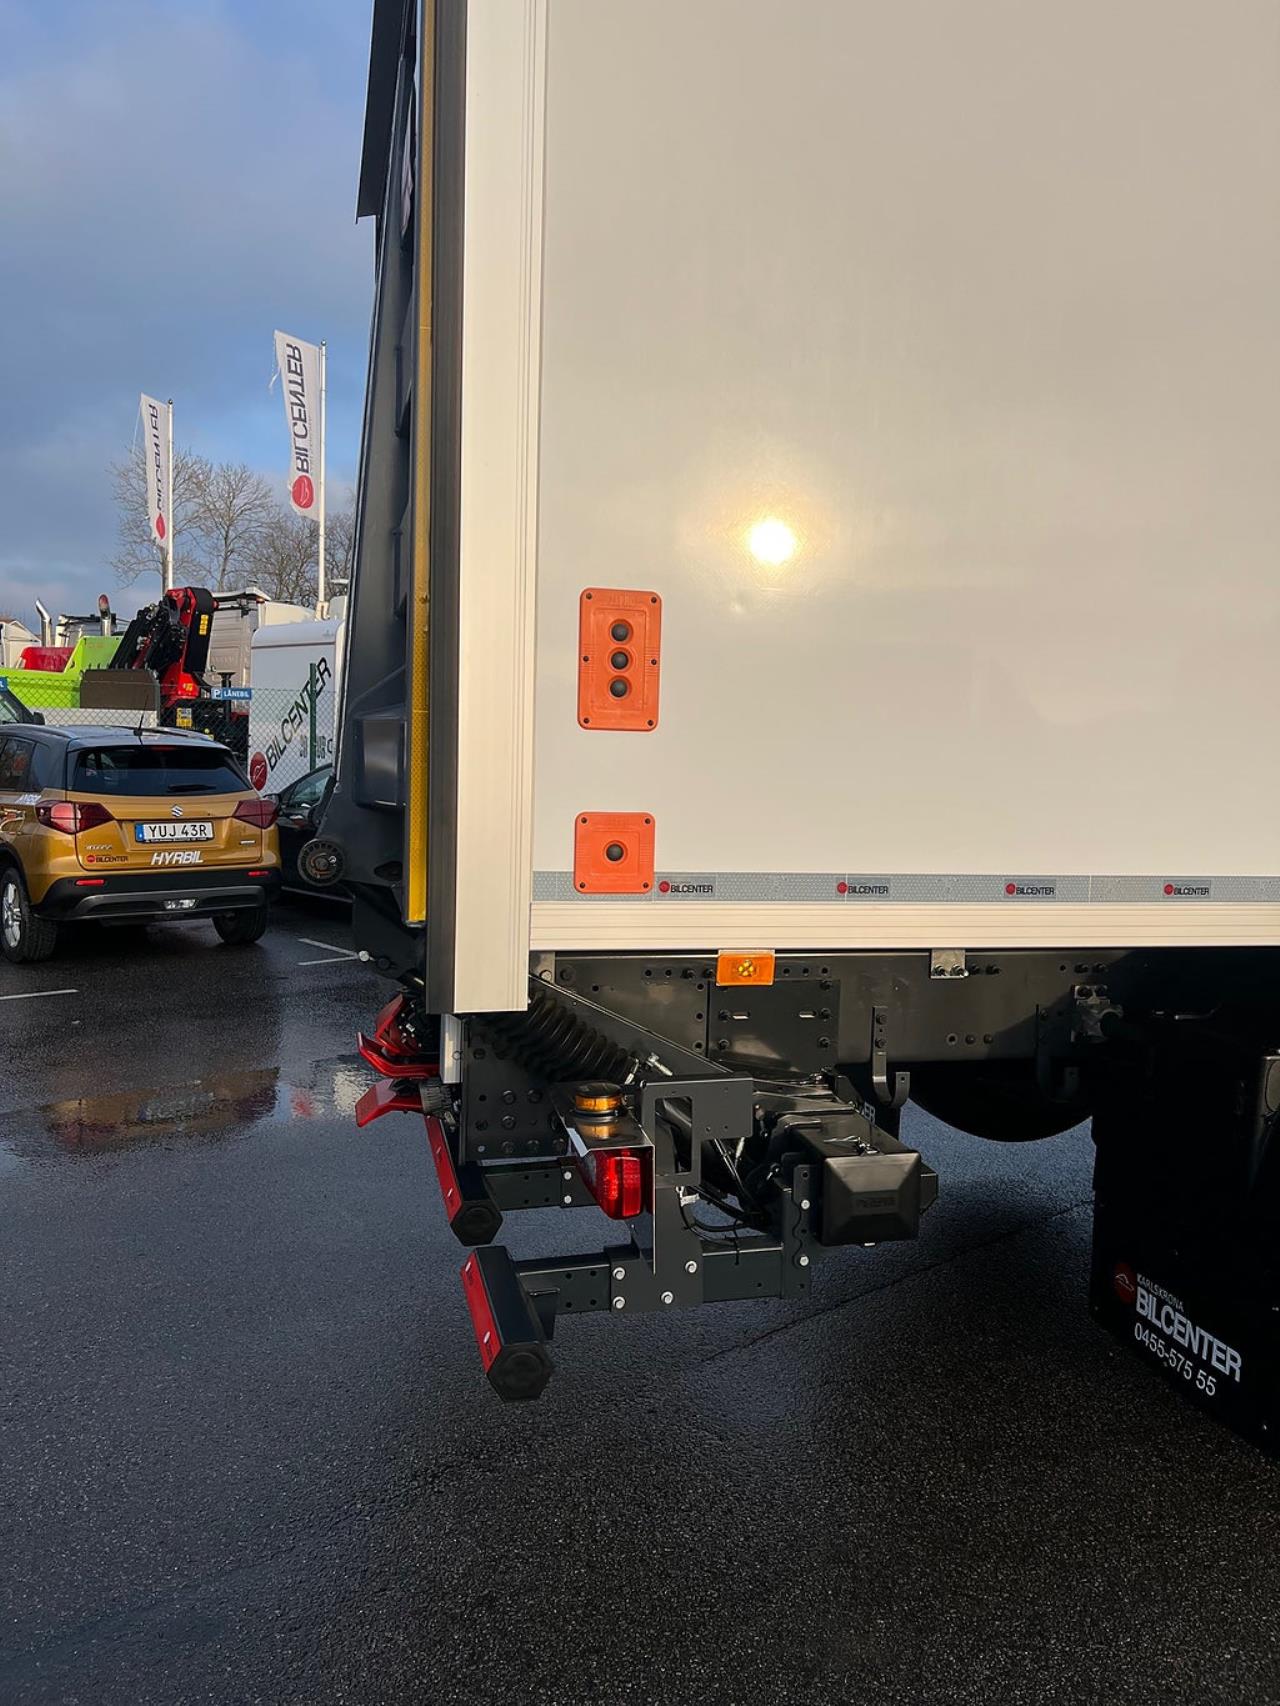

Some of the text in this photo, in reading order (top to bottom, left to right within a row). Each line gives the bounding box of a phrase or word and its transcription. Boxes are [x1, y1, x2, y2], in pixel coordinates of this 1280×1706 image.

[265, 656, 332, 772] BILCENTER
[149, 824, 207, 837] YUJ 43R
[150, 850, 204, 866] HYRBIL
[670, 884, 713, 893] BILCENTER
[848, 885, 889, 894] BILCENTER
[1015, 886, 1055, 896] BILCENTER
[1173, 886, 1210, 896] BILCENTER
[1135, 1286, 1242, 1383] BILCENTER
[1134, 1322, 1217, 1396] 0455-575 55
